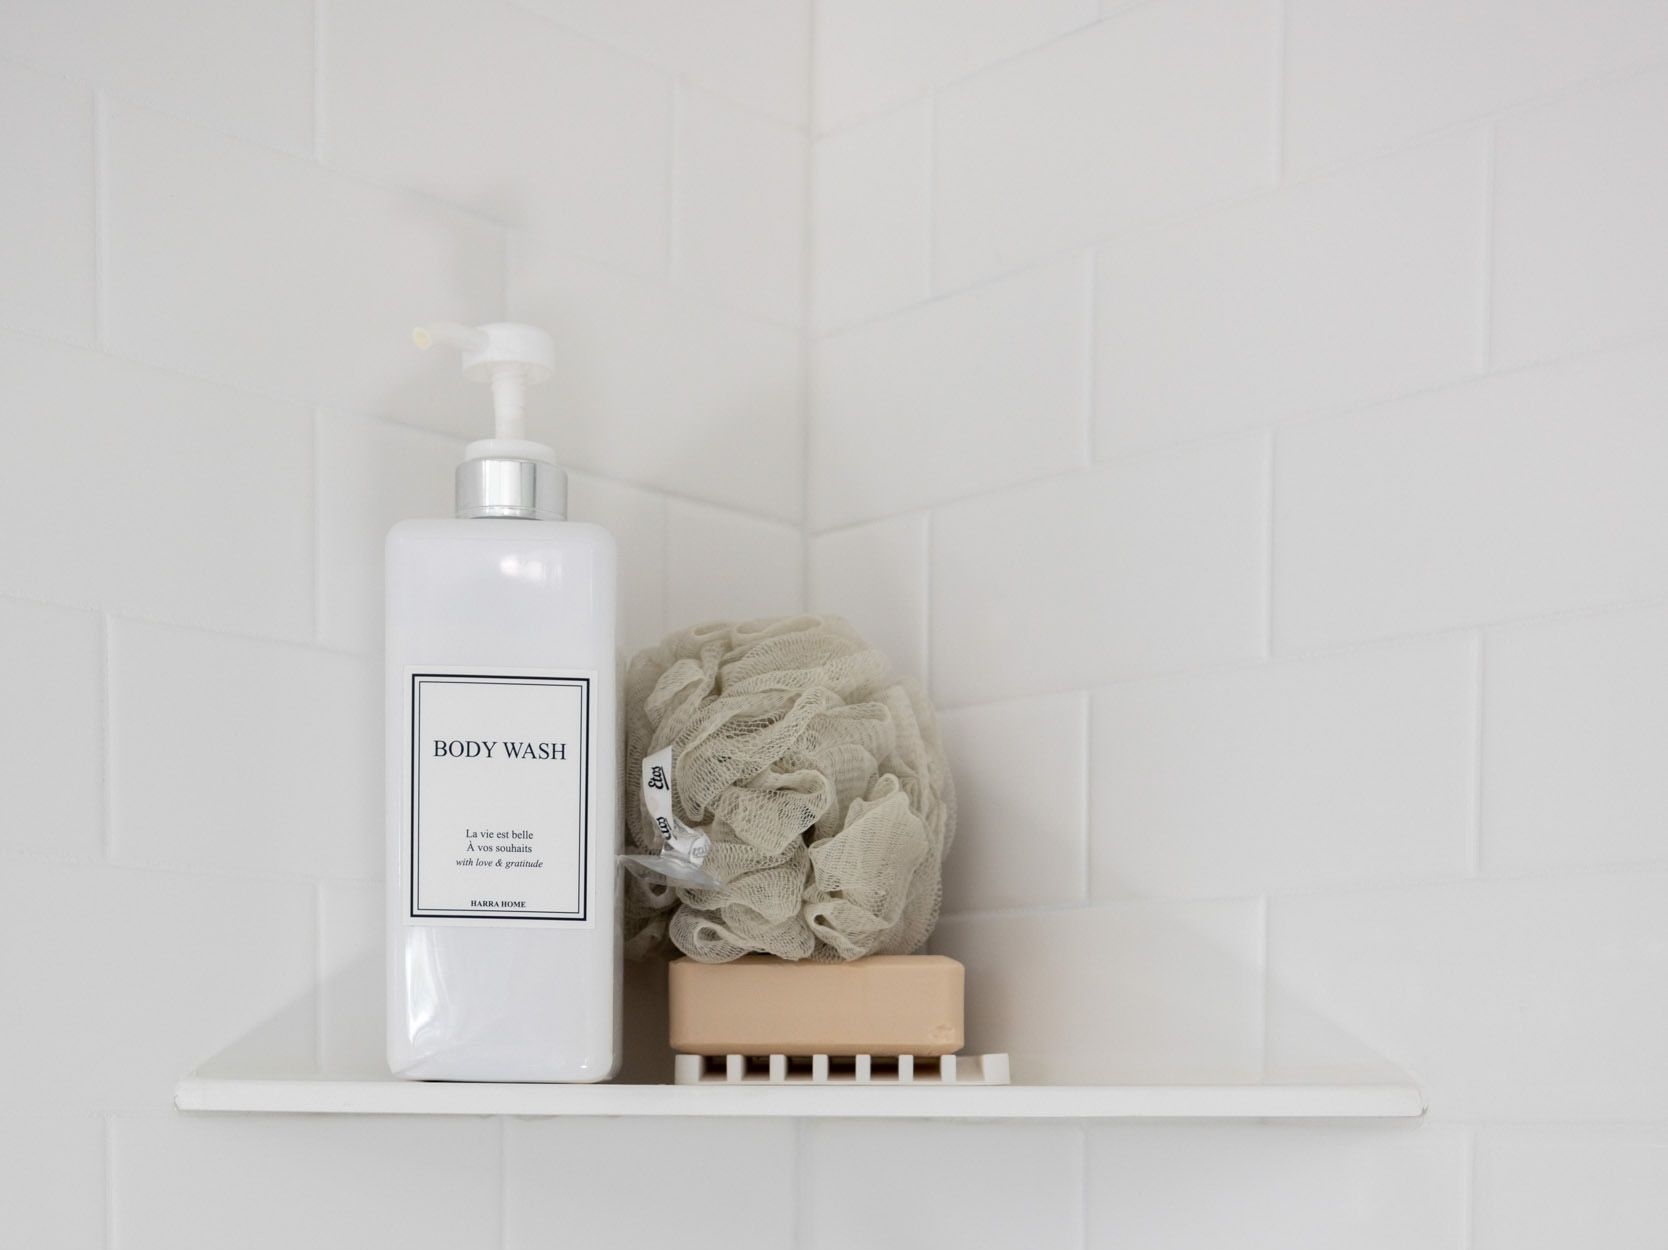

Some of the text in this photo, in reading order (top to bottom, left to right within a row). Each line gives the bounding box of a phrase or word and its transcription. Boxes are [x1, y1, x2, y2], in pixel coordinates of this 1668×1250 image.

[434, 740, 567, 760] BODY WASH
[648, 766, 665, 790] Etos
[466, 829, 534, 840] La vie est belle
[467, 841, 532, 853] À vos souhaits
[456, 858, 543, 869] with love & gratitude
